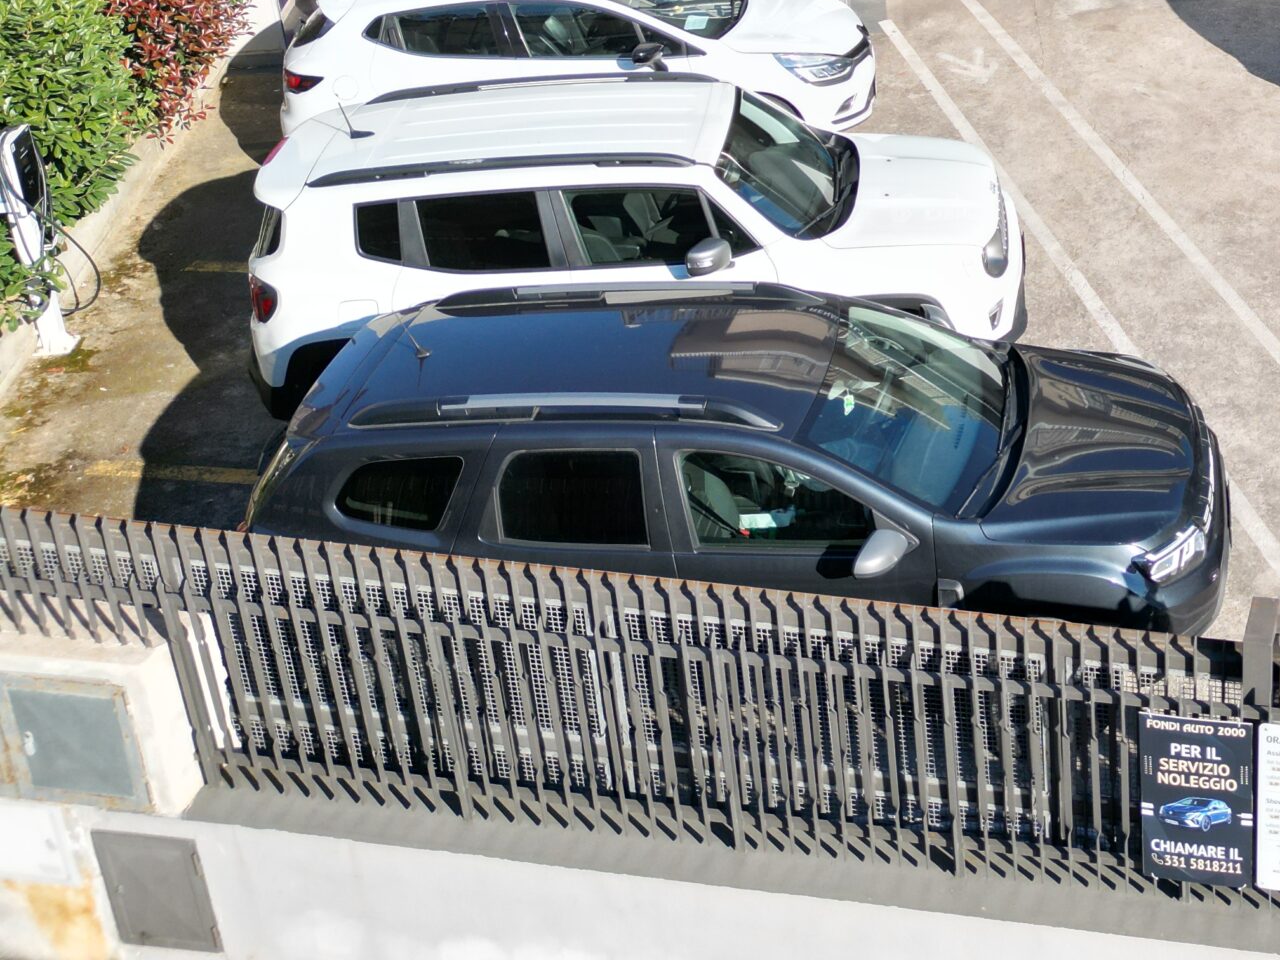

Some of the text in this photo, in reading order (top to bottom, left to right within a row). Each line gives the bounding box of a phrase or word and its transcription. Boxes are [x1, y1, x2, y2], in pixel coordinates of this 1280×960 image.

[1146, 718, 1246, 737] FONDI AUTO 2000
[1170, 742, 1221, 760] PER IL
[1159, 757, 1230, 777] SERVIZIO
[1157, 772, 1238, 792] NOLEGGIO
[1151, 838, 1244, 861] CHIAMARE IL
[1164, 854, 1242, 874] 331 5818211
